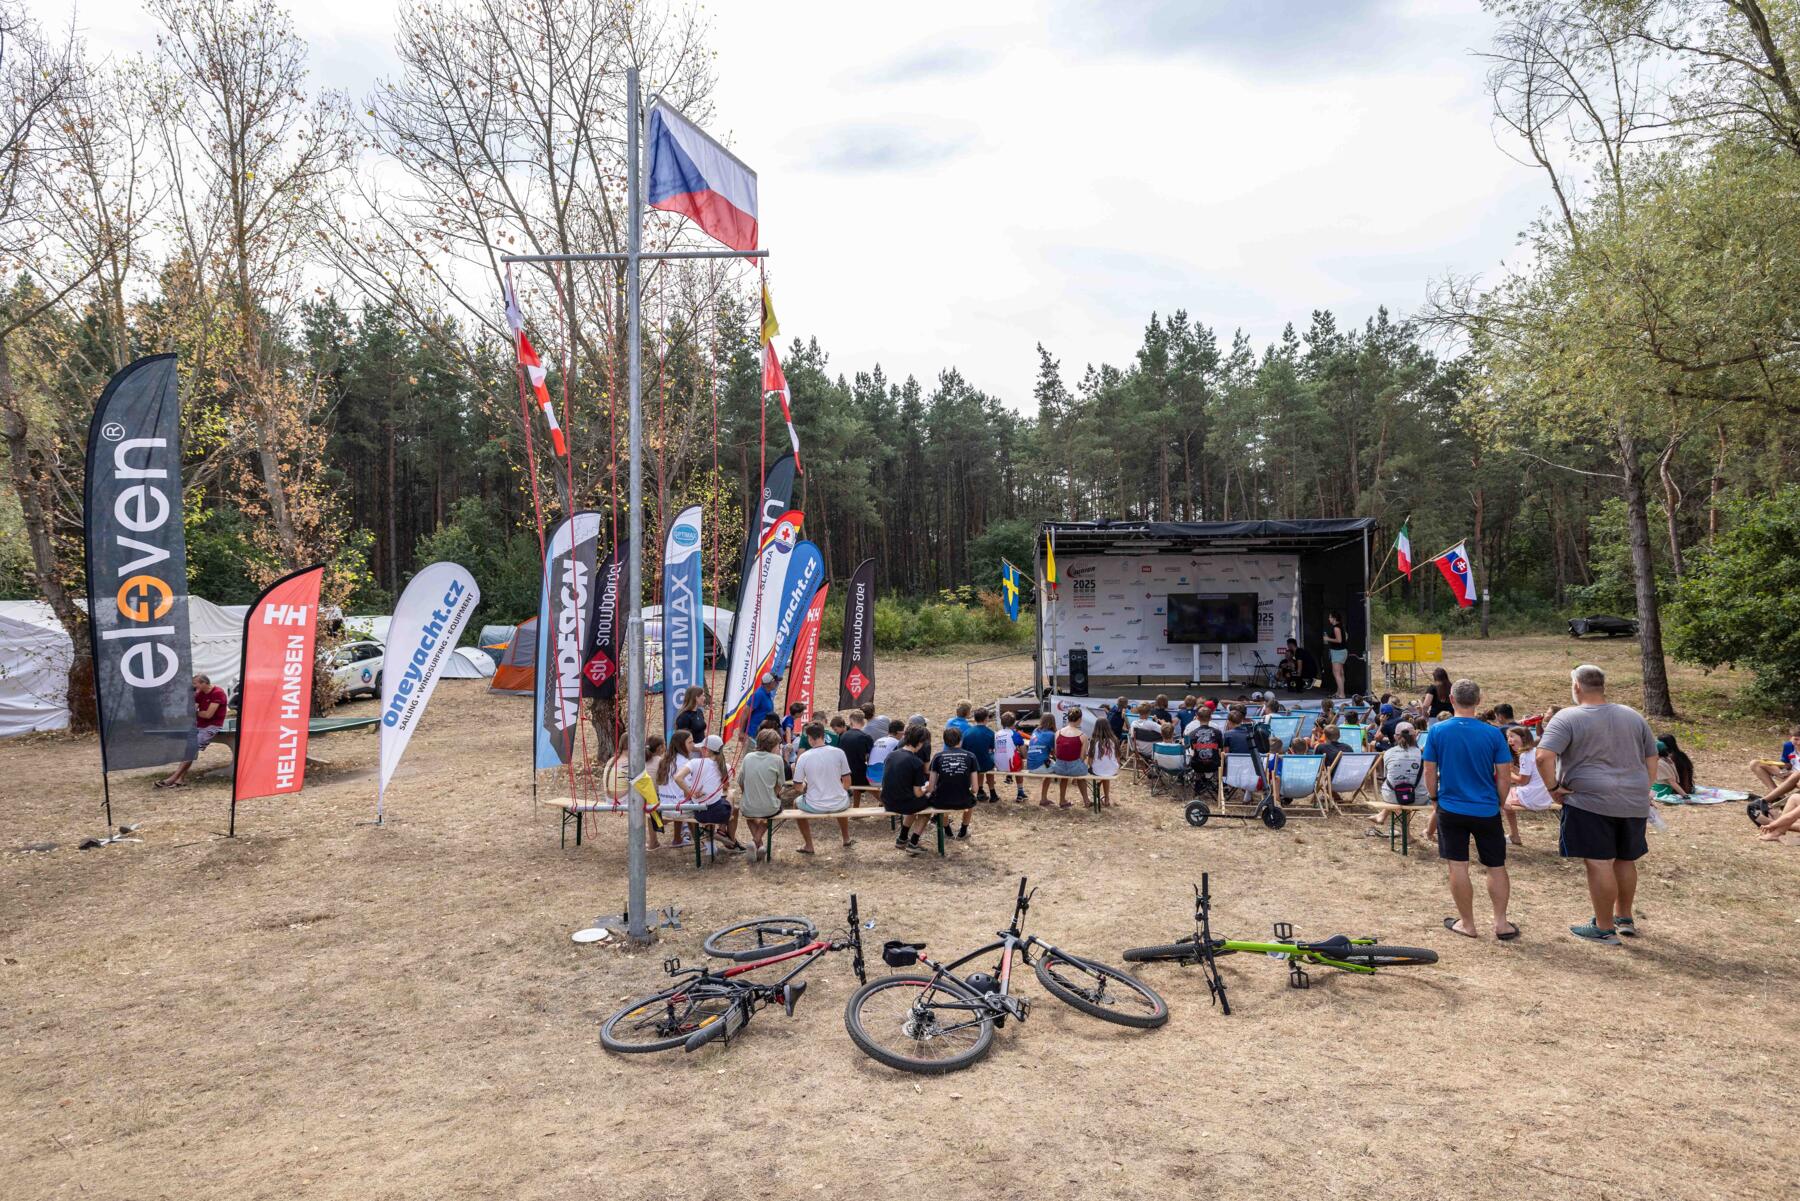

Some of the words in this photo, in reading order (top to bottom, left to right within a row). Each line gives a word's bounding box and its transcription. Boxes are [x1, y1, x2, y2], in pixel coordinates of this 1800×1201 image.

[771, 556, 817, 668] eyacht.cz
[853, 582, 866, 661] snowboardel
[1073, 579, 1096, 588] 2025
[281, 635, 305, 719] HANSEN
[383, 579, 465, 727] oneyacht.cz
[399, 699, 419, 732] SAILING
[417, 640, 448, 694] WINDSURFING
[447, 592, 474, 635] EQUIPMENT
[554, 559, 589, 731] WINDESIGN
[591, 659, 608, 681] sbl
[671, 574, 689, 710] OPTIMAX
[802, 627, 818, 685] HANSEN
[850, 673, 863, 693] sbl
[276, 725, 298, 789] HELLY
